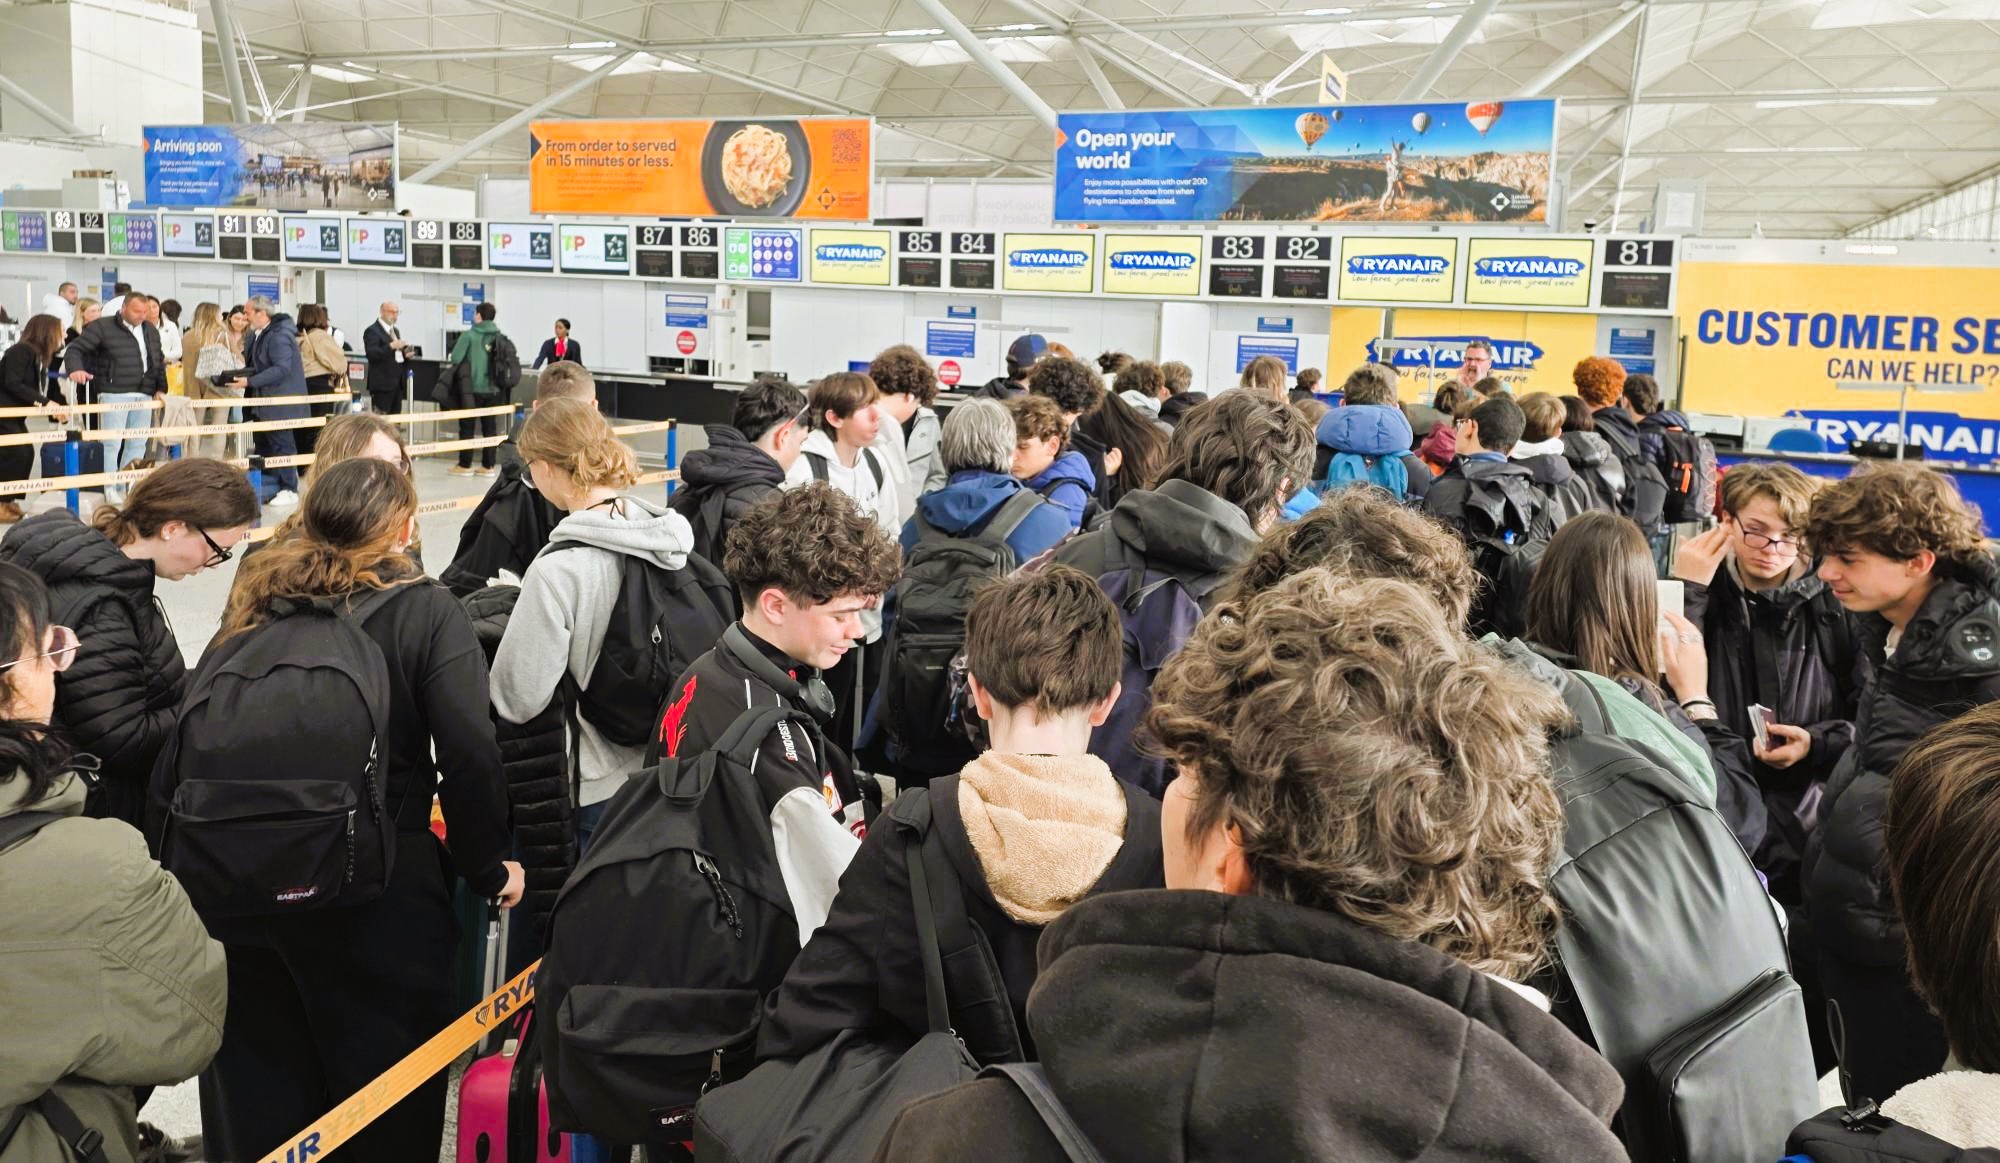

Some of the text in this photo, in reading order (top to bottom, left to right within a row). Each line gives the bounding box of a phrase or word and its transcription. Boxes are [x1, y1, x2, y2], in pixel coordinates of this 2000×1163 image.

[154, 139, 222, 156] Arriving soon
[546, 139, 677, 152] From order to served
[1075, 129, 1176, 150] Open your
[546, 154, 674, 167] in 15 minutes or less.
[1075, 151, 1131, 169] world
[1084, 178, 1102, 188] Enjoy
[1161, 178, 1175, 186] with
[1192, 177, 1208, 186] 200
[1175, 188, 1195, 196] when
[1083, 197, 1102, 206] flying
[1102, 197, 1119, 205] from
[1119, 197, 1144, 205] London
[55, 211, 71, 229] 93
[85, 213, 99, 229] 92
[223, 215, 239, 233] 91
[256, 216, 274, 234] 90
[417, 220, 437, 240] 89
[456, 223, 476, 240] 88
[643, 226, 666, 245] 87
[687, 227, 711, 246] 86
[907, 232, 933, 253] 85
[959, 233, 986, 253] 84
[1222, 236, 1254, 259] 83
[1287, 237, 1319, 260] 82
[826, 246, 884, 259] RYANAIR
[1021, 252, 1085, 265] RYANAIR
[1122, 254, 1192, 267] RYANAIR
[1619, 240, 1655, 266] 81
[1362, 258, 1444, 272] RYANAIR
[1491, 261, 1579, 275] RYANAIR
[1698, 309, 1939, 353] CUSTOMER
[1403, 346, 1533, 365] RYAAIR
[1827, 358, 2000, 386] CAN WE HELP?
[1817, 418, 2000, 455] RYANAI
[3, 480, 54, 493] RYANAIR
[418, 501, 457, 514] RYANAIR
[268, 1131, 321, 1163] IR
